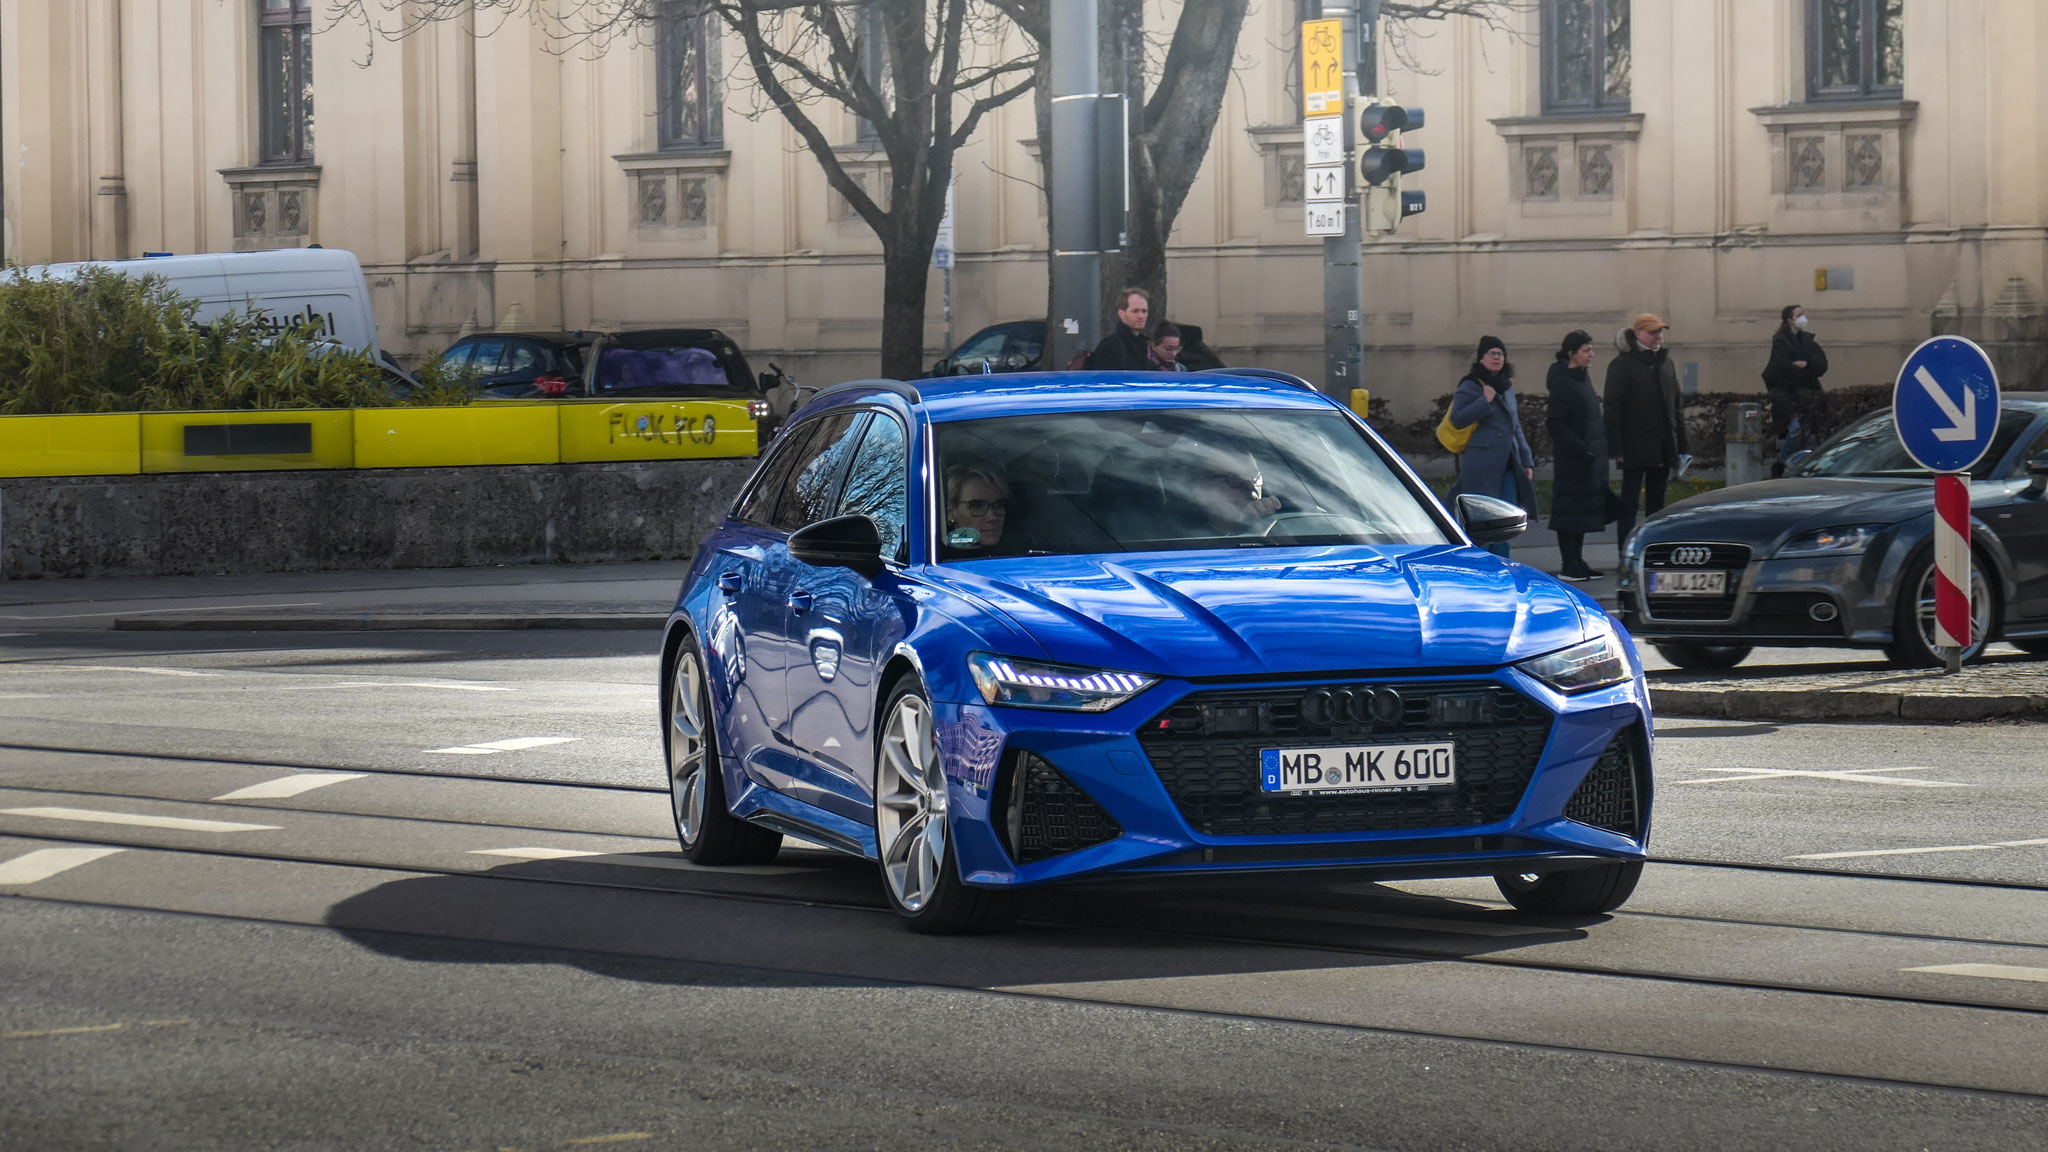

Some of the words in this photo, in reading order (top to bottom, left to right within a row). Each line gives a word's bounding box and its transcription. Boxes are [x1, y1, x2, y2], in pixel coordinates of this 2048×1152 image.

[1315, 214, 1326, 227] 60
[1690, 573, 1724, 591] 1247
[1268, 774, 1276, 784] D
[1282, 753, 1323, 785] MB
[1345, 750, 1386, 783] MK
[1394, 748, 1450, 780] 600
[1319, 787, 1402, 796] www.autohaus-rinner.de
